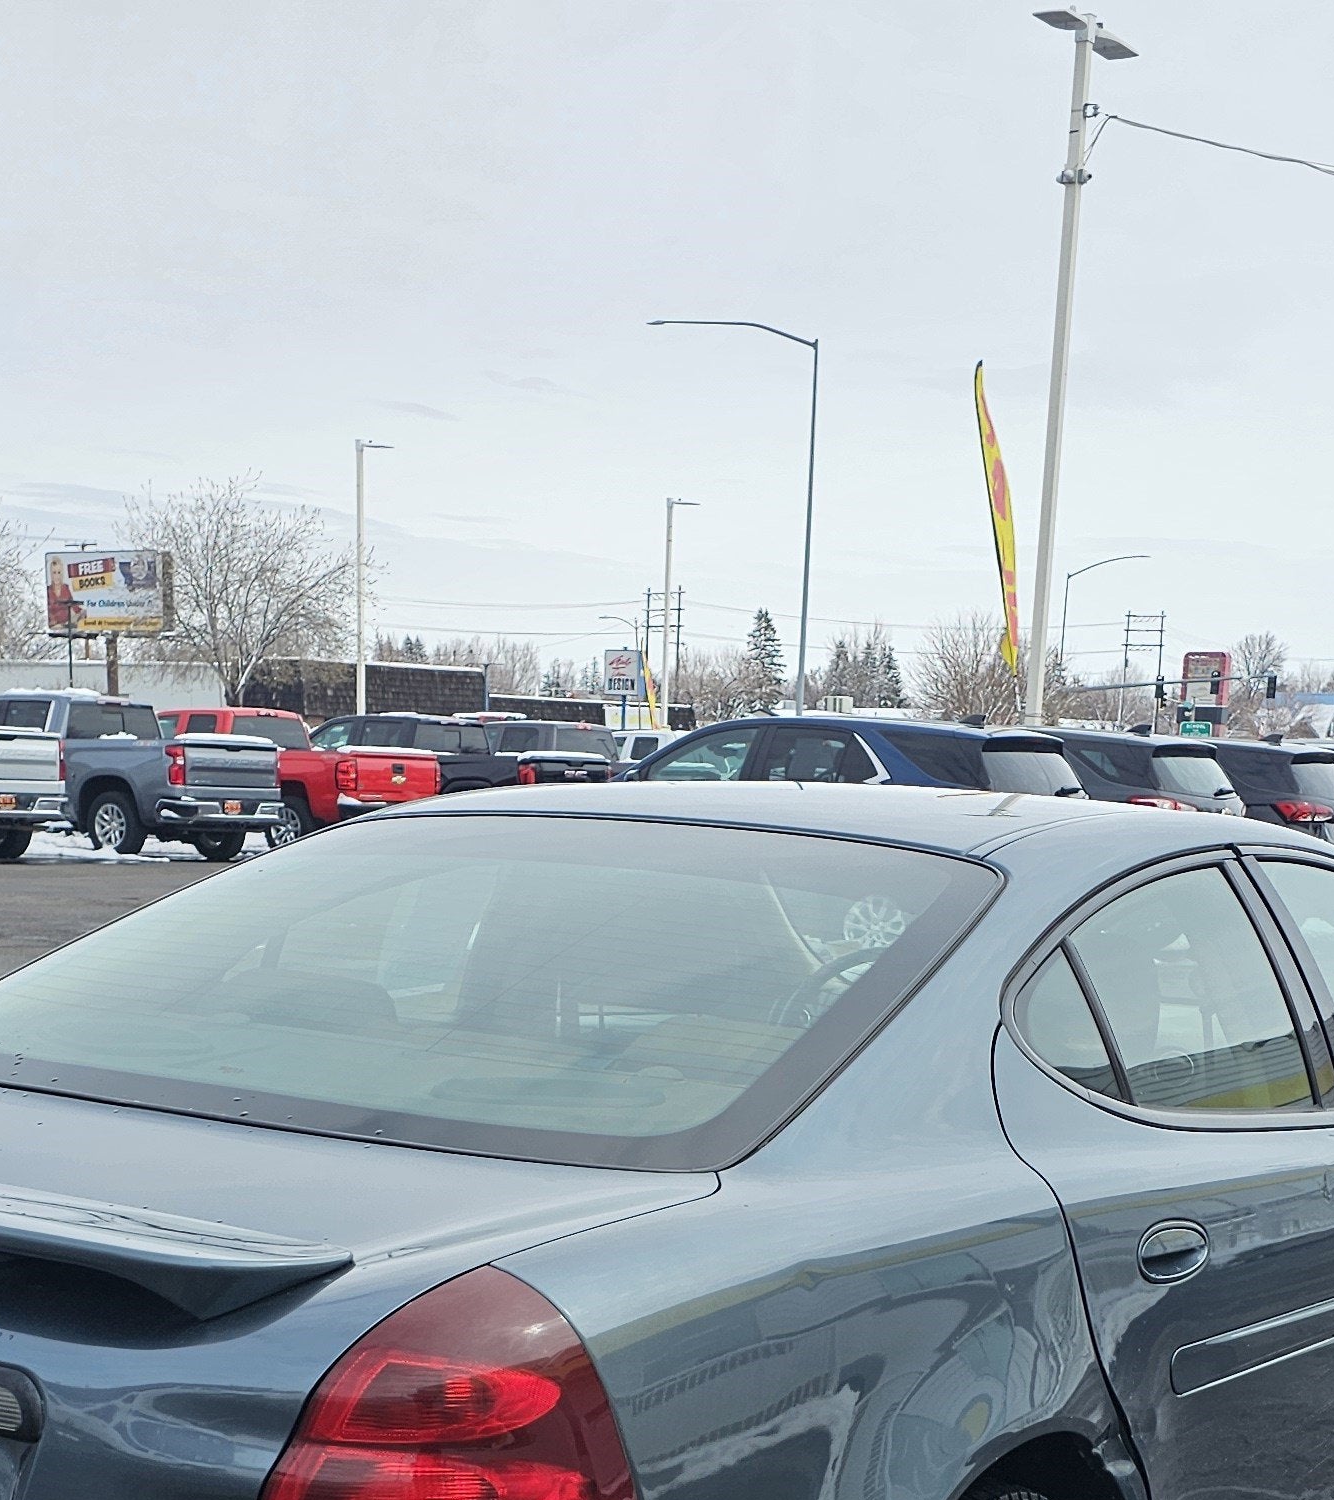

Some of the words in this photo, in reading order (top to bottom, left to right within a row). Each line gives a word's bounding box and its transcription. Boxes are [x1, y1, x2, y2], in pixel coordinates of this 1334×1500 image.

[78, 560, 104, 576] FREE
[78, 576, 106, 589] BOOKS
[607, 677, 636, 691] DESIGN
